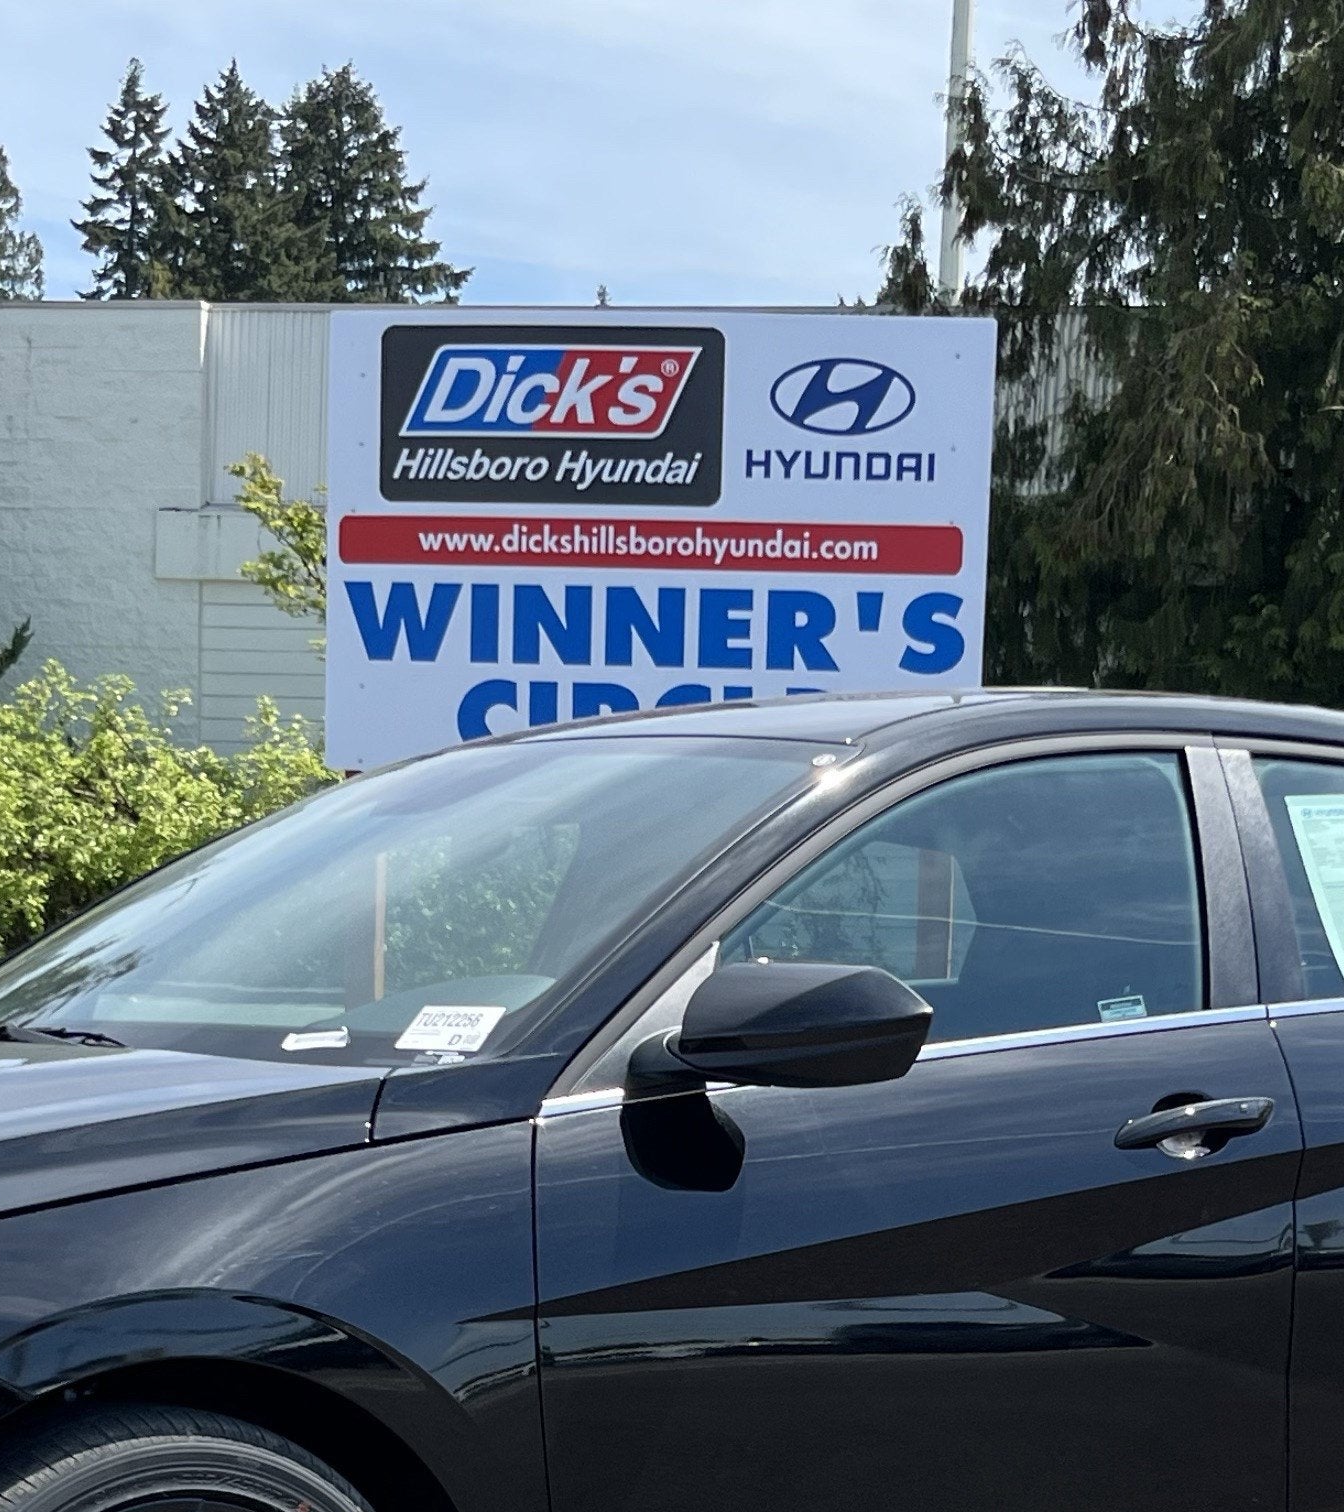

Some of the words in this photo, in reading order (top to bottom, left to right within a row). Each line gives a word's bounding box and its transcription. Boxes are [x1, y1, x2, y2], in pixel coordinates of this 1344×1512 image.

[392, 448, 549, 481] Hillsboro
[554, 450, 703, 491] Hyundai
[745, 448, 936, 482] HYUNDAI
[418, 524, 878, 565] www.dickshillsborohyundai.com
[344, 581, 966, 675] WINNER'S
